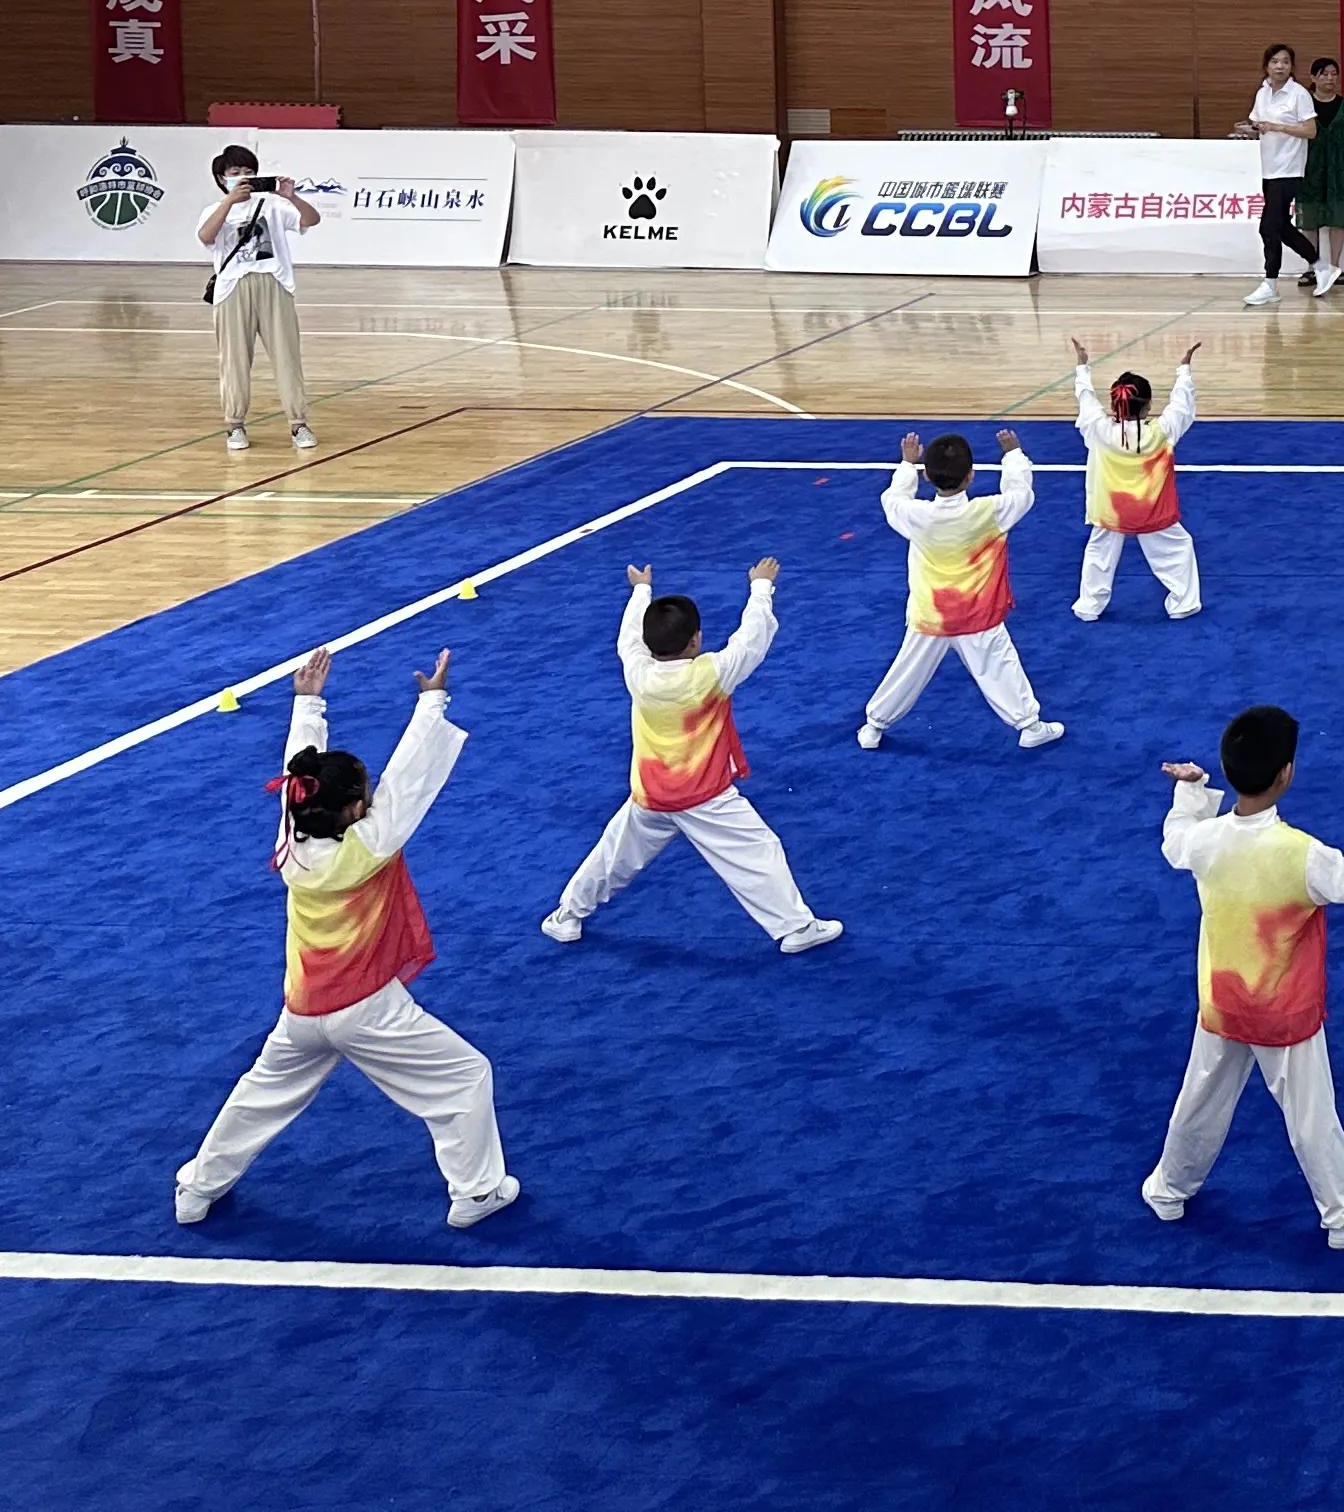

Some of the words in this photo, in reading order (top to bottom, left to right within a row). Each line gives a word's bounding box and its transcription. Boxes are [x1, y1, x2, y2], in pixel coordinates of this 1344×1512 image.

[353, 188, 485, 209] 白石峡山泉水
[878, 181, 1008, 199] 中国城市篮球联赛
[861, 202, 1012, 238] CCBL
[604, 224, 679, 241] KELME
